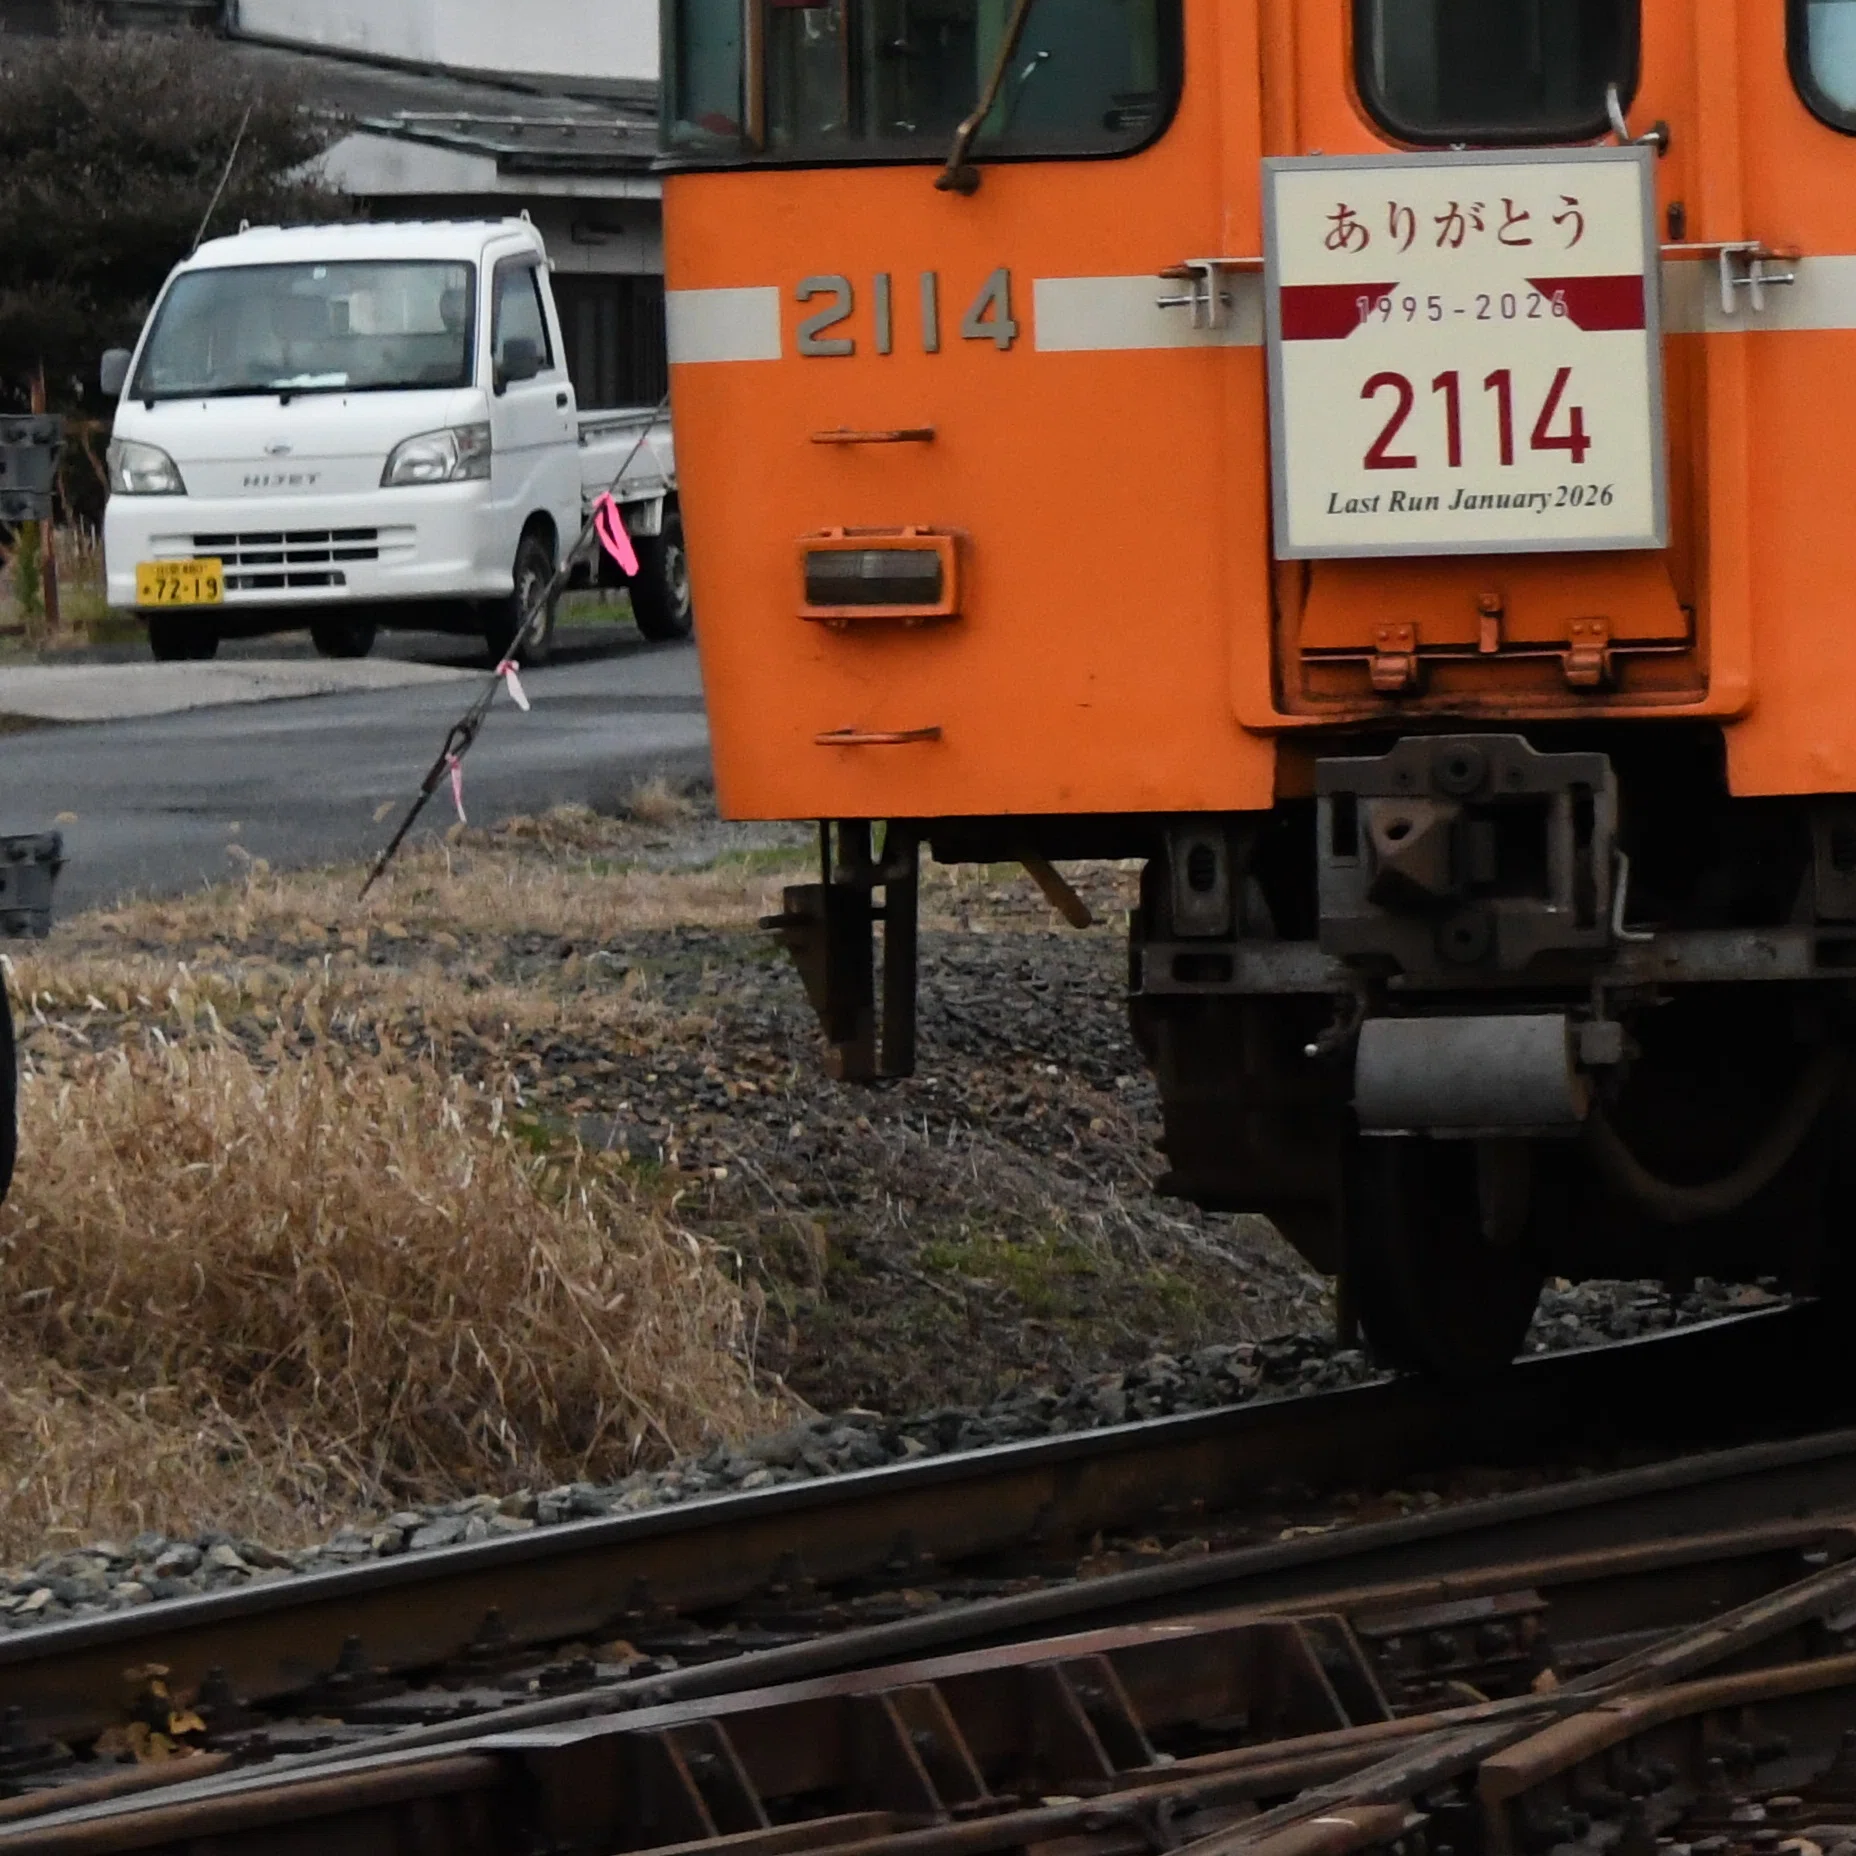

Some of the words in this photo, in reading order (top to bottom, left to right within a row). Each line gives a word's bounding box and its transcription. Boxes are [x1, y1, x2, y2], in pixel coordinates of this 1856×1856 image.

[1323, 194, 1586, 254] ありがとう
[794, 266, 1022, 358] 2114
[1355, 288, 1570, 324] 1995-2026
[1360, 366, 1592, 471] 2114
[1326, 492, 1381, 515] Last
[1387, 489, 1440, 514] Run
